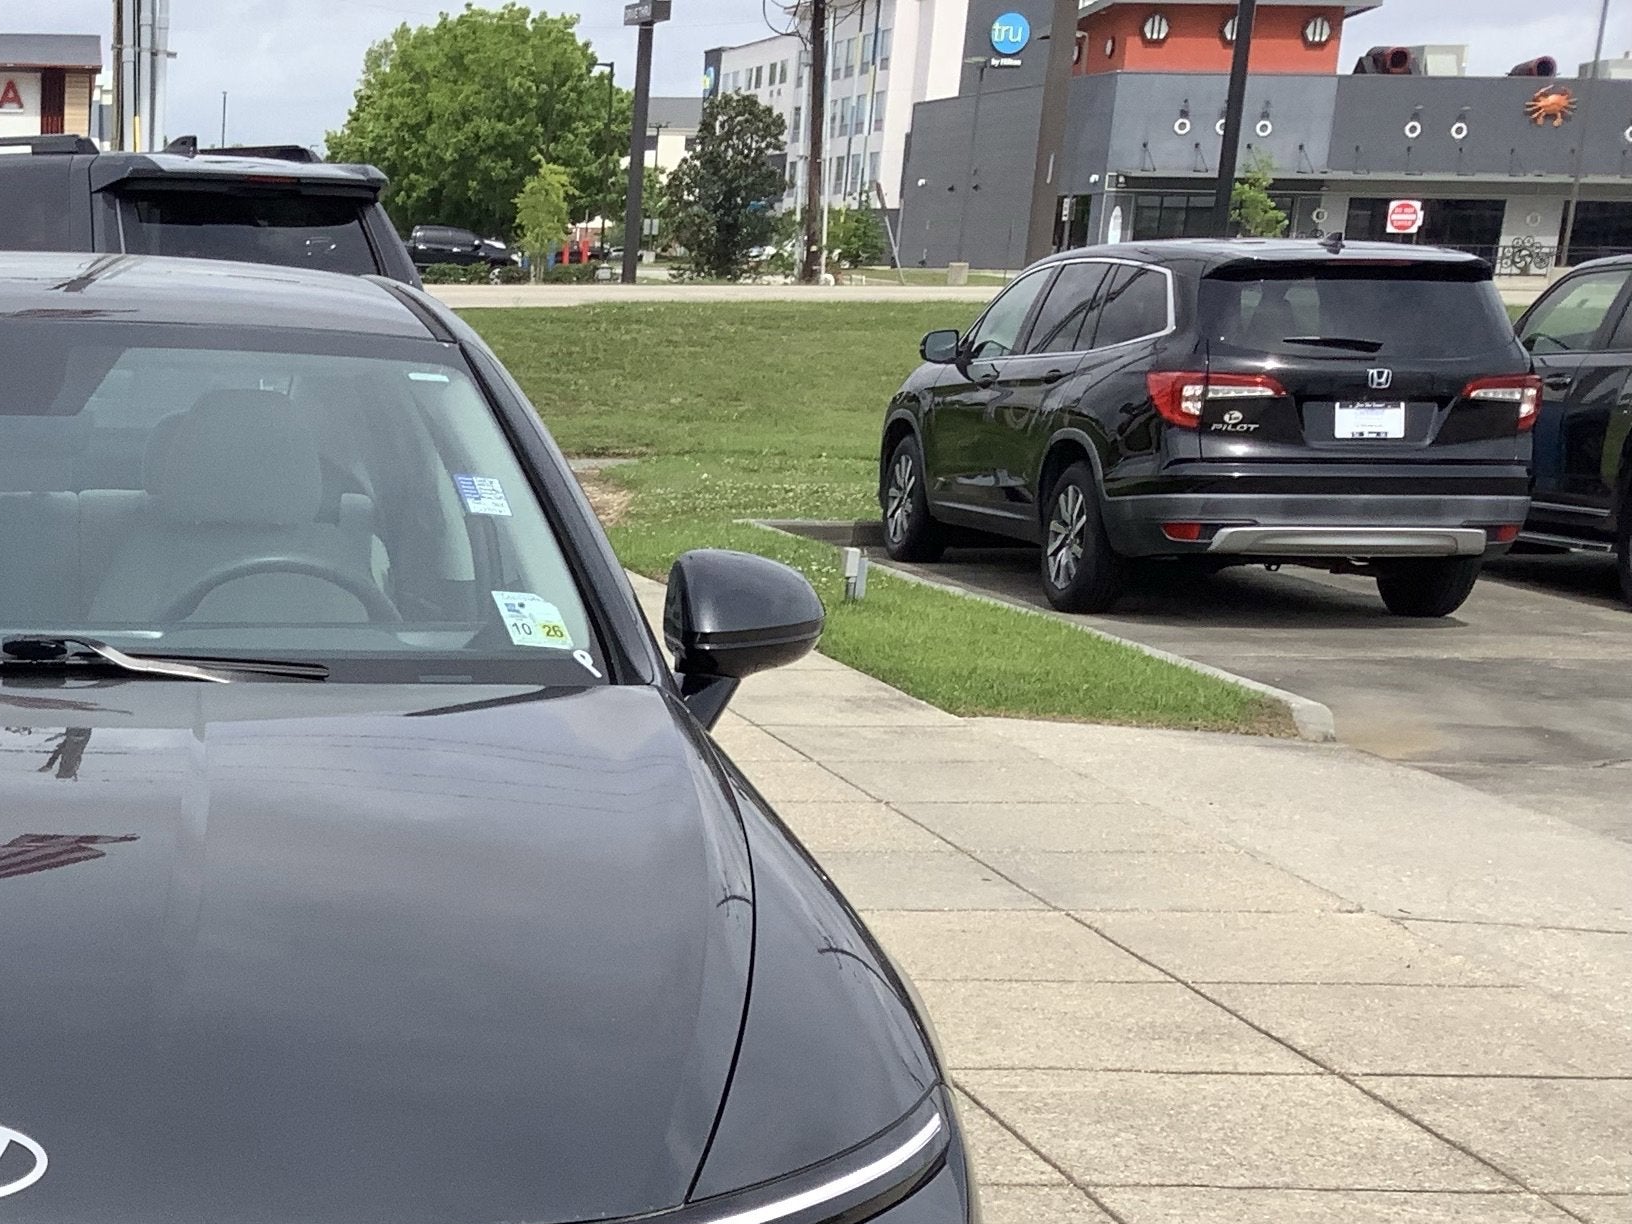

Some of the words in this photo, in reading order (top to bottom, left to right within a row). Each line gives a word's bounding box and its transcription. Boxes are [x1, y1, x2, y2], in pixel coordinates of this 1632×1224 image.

[992, 22, 1023, 42] tru
[1210, 423, 1260, 431] PILOT
[511, 622, 533, 636] 10
[542, 624, 565, 638] 26
